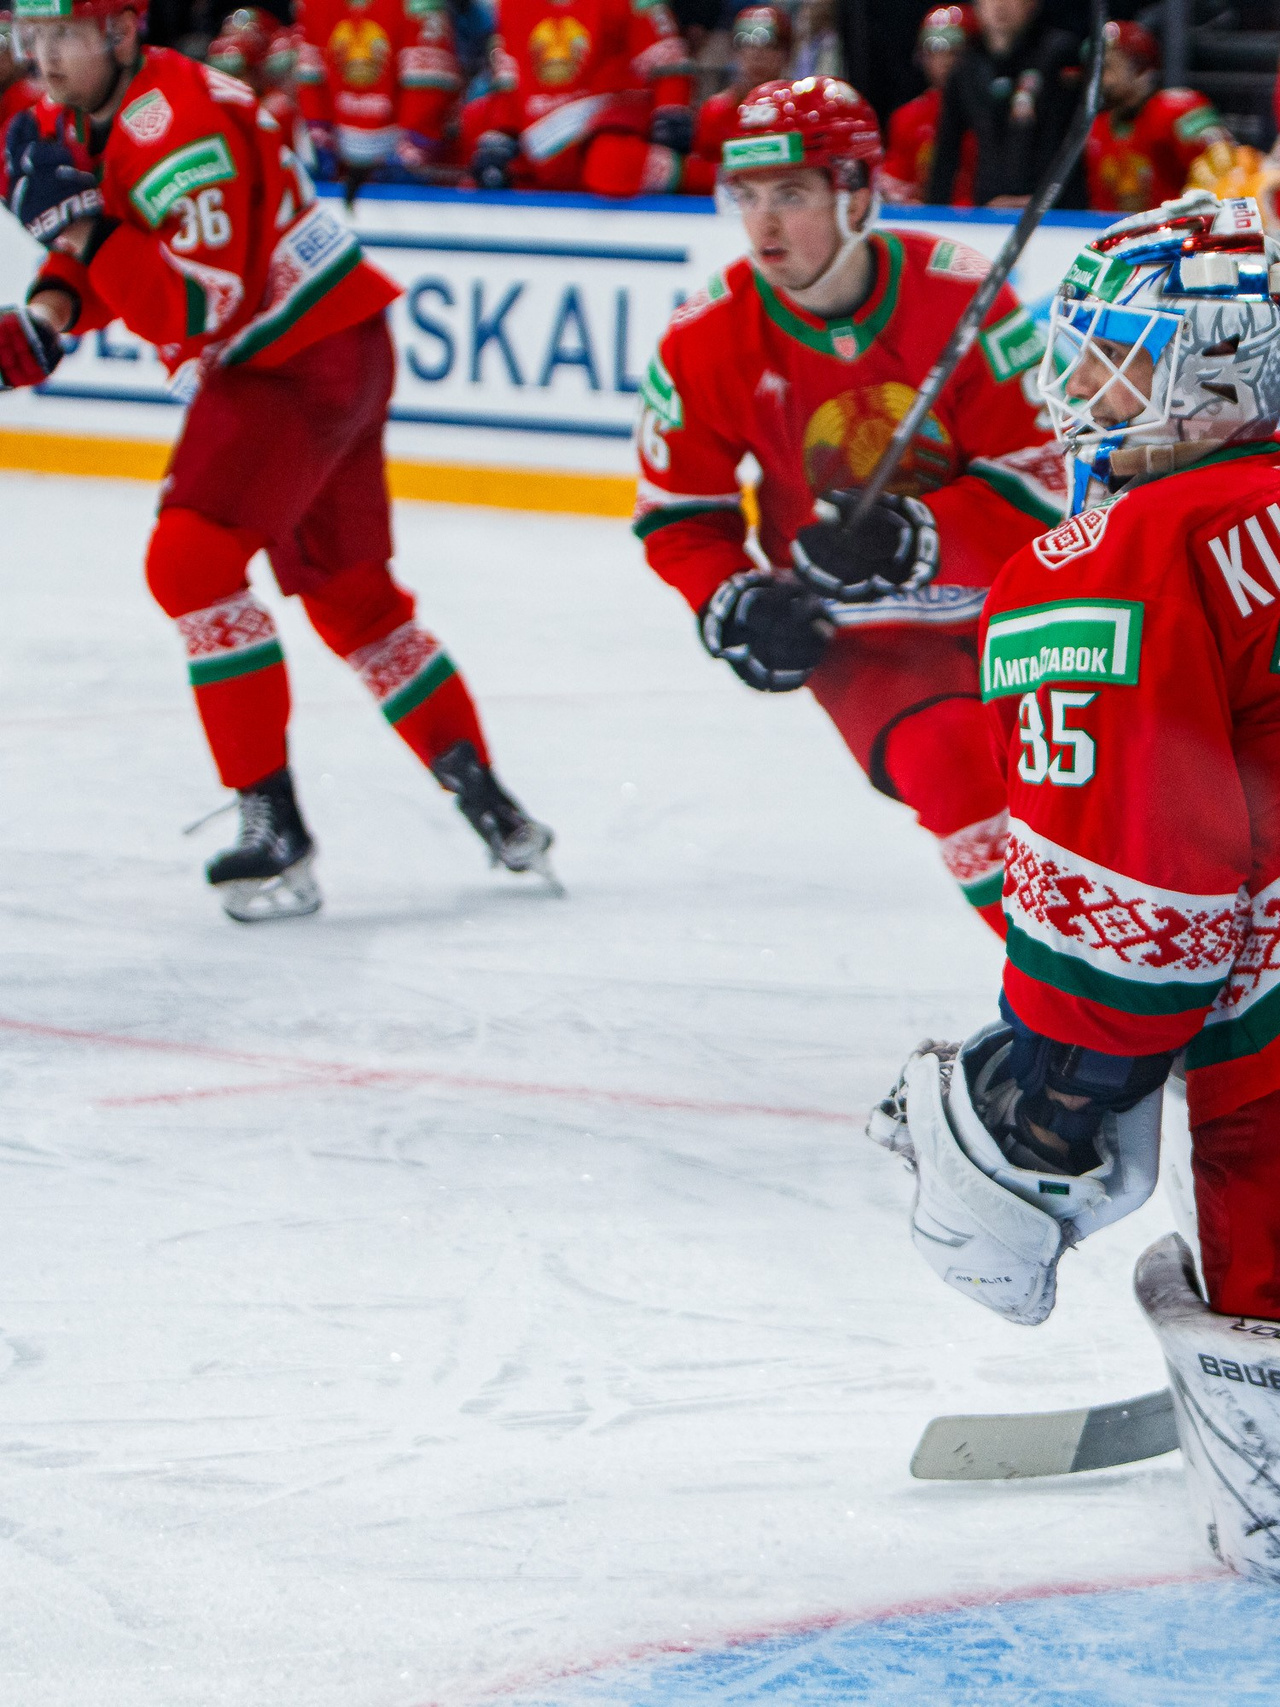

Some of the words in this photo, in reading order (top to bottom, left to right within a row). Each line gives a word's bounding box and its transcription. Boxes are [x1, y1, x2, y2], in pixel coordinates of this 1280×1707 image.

[171, 188, 231, 251] 36
[406, 272, 690, 394] SKAL
[1018, 690, 1100, 786] 35
